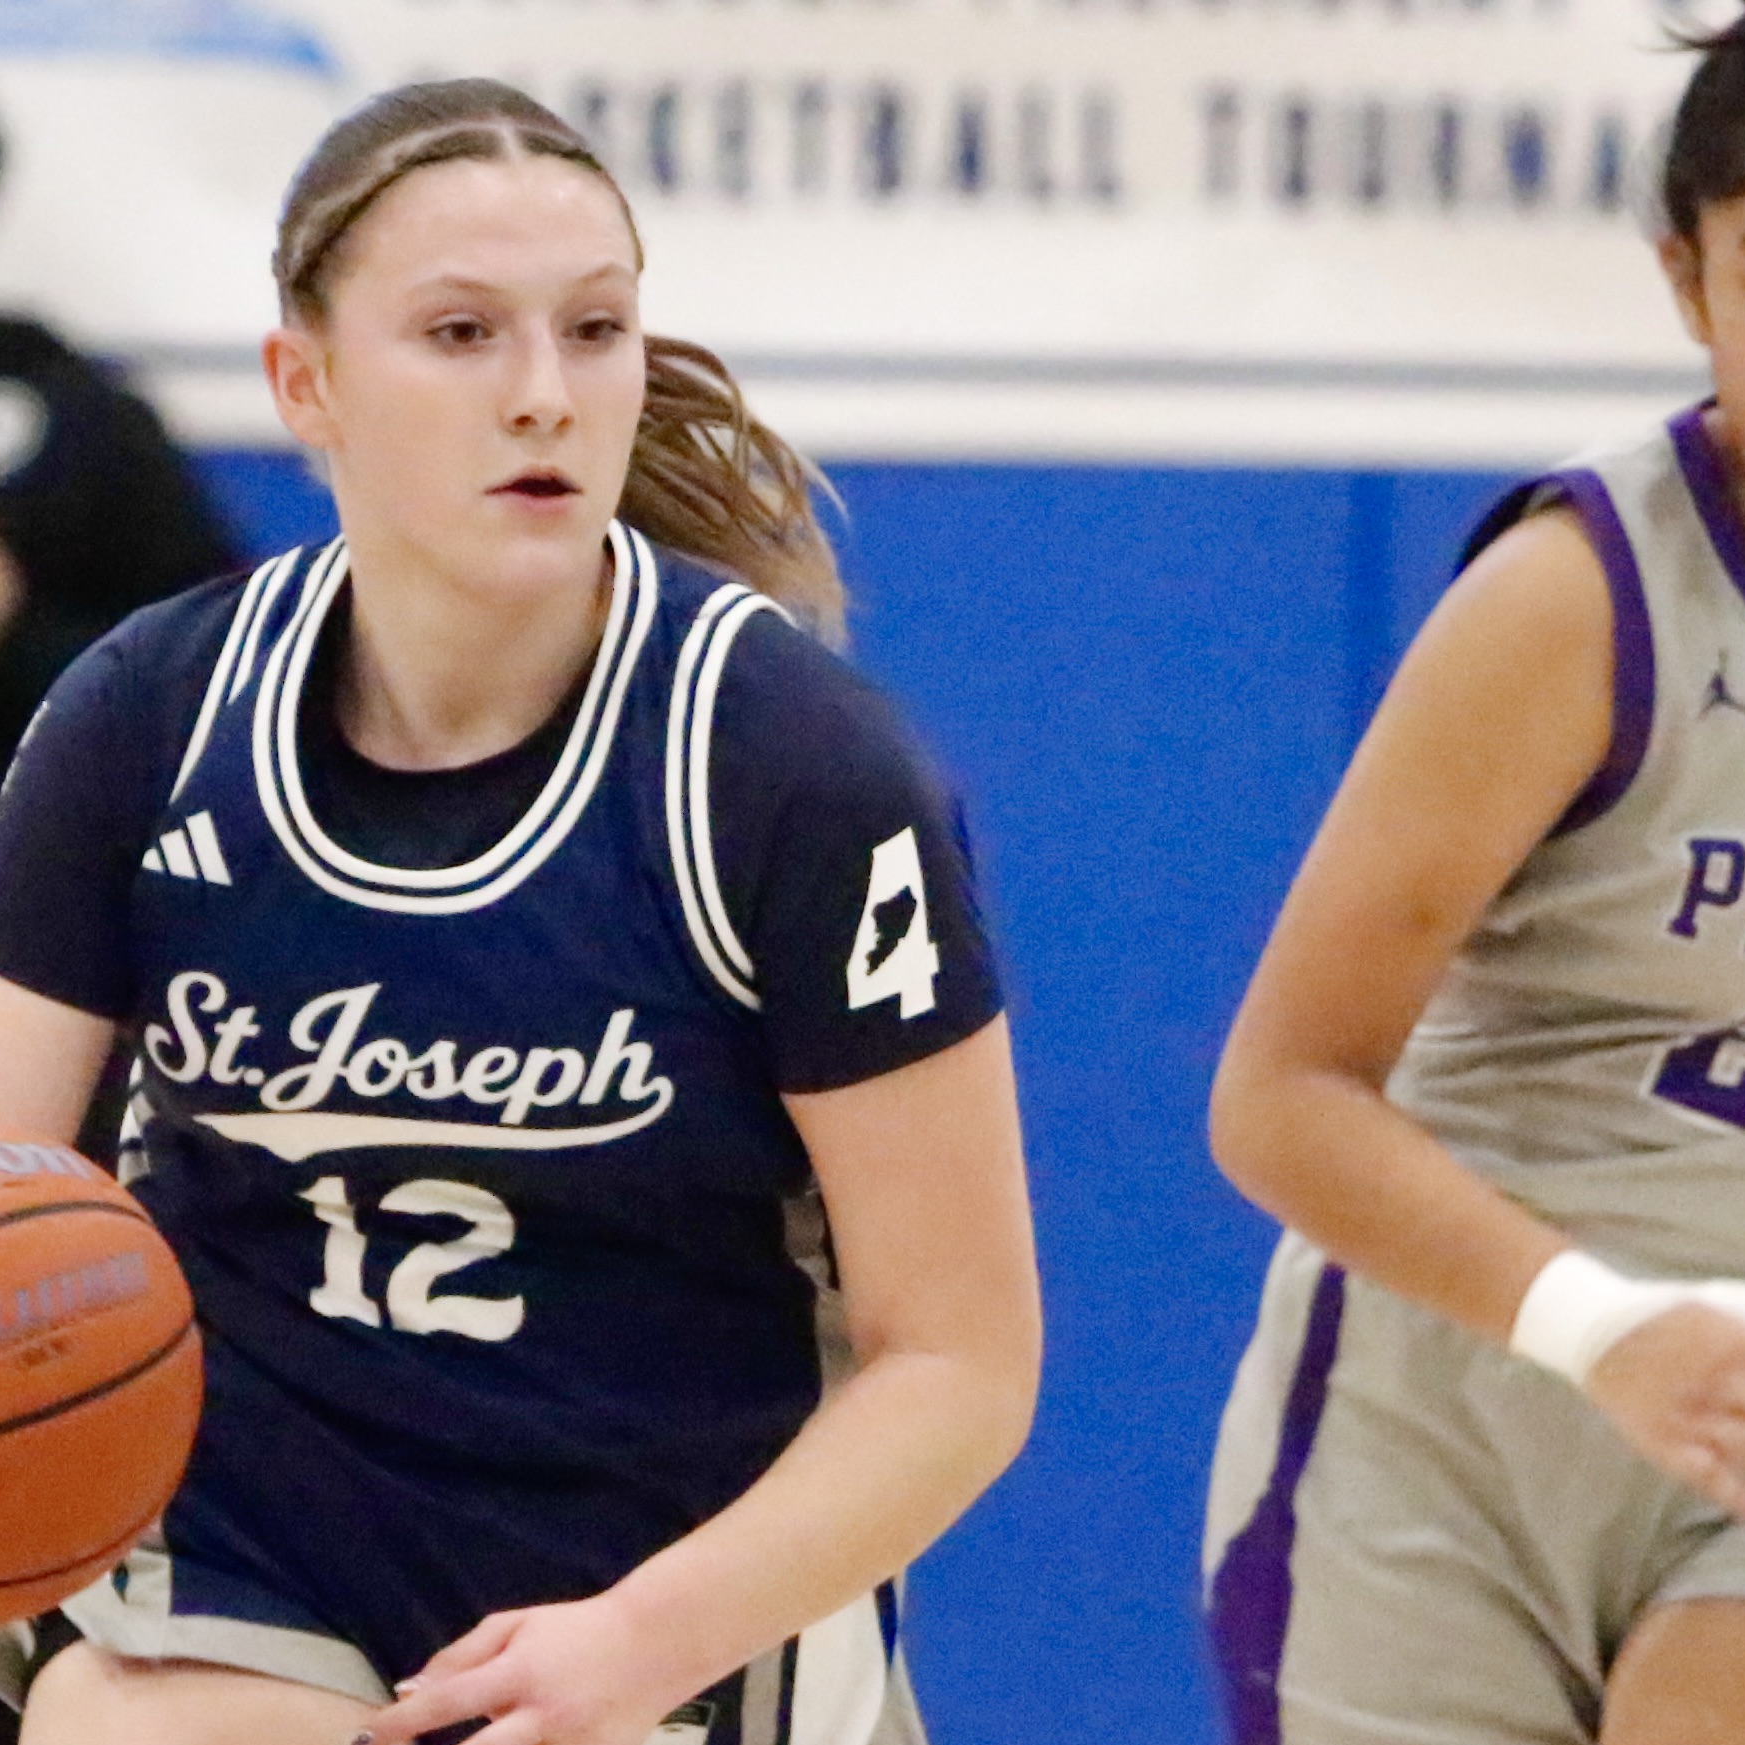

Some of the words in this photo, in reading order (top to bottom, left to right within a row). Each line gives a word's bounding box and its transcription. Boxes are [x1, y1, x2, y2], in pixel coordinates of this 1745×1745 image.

[1197, 86, 1665, 210] TOURNA
[845, 825, 940, 1020] 4
[259, 982, 675, 1126] Joseph
[296, 1175, 525, 1342] 12
